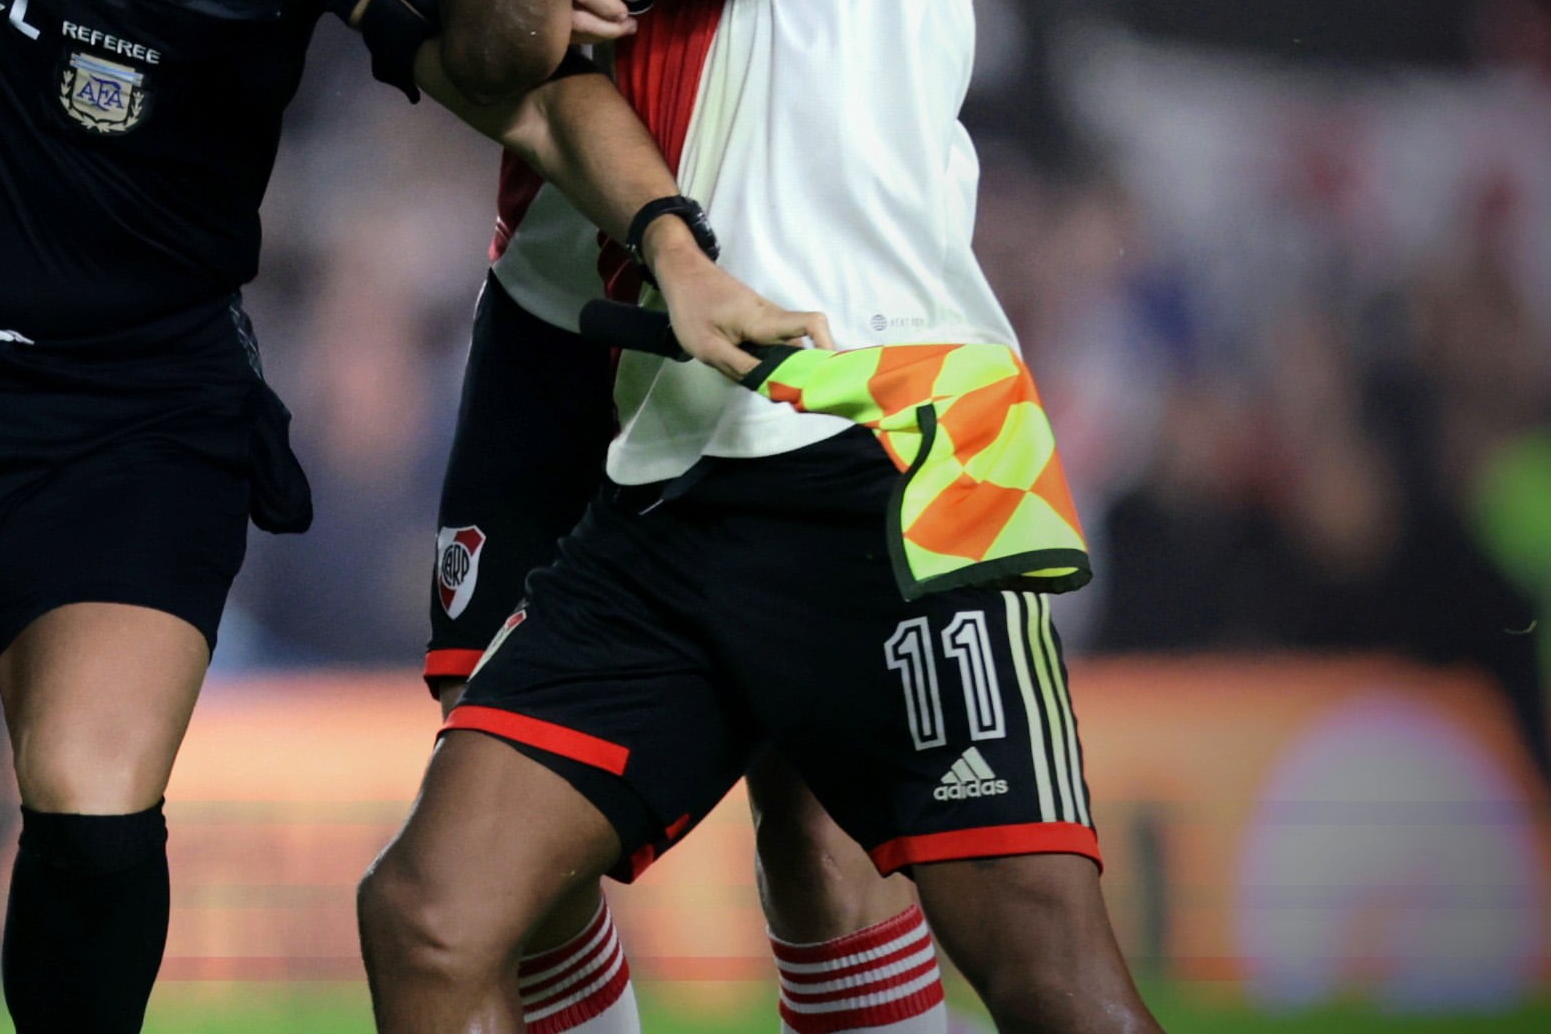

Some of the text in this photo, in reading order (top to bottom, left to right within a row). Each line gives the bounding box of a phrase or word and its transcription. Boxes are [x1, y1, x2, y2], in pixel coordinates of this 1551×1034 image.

[62, 20, 161, 65] REFEREE
[883, 610, 1007, 752] 11
[933, 779, 1009, 803] adidas
